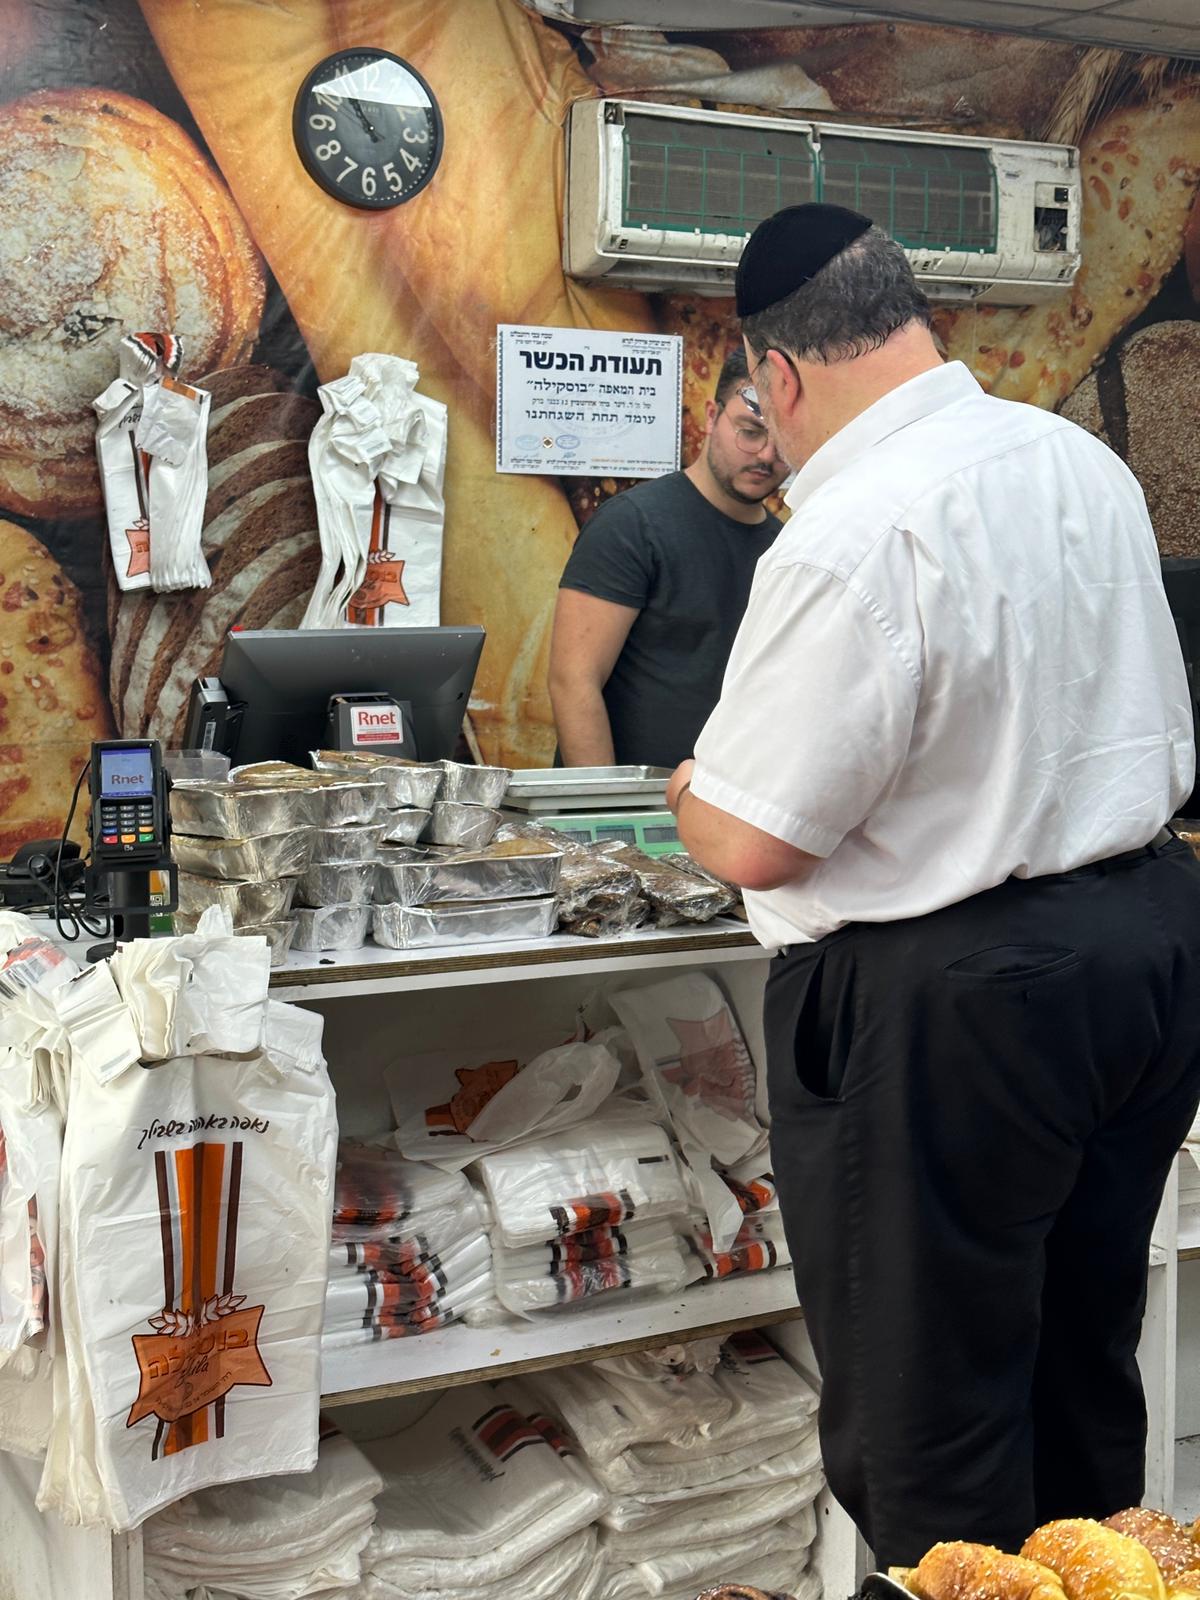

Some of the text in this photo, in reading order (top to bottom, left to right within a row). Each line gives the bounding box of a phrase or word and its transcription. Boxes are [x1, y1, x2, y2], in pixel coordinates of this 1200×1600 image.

[335, 64, 358, 92] 11
[362, 62, 381, 92] 12
[315, 83, 343, 112] 10
[309, 114, 336, 131] 9
[402, 127, 428, 144] 3
[315, 139, 341, 161] 8
[399, 148, 423, 172] 4
[336, 156, 358, 183] 7
[361, 167, 376, 196] 6
[382, 162, 402, 192] 5
[519, 350, 662, 376] תעודת הכשר
[599, 383, 634, 396] המאפה
[638, 386, 656, 396] בית
[525, 409, 656, 424] עומד תחת השגחתנו
[358, 711, 396, 725] Rnet
[111, 774, 145, 785] Rnet
[137, 1113, 269, 1150] נאפה באהה בשבילך
